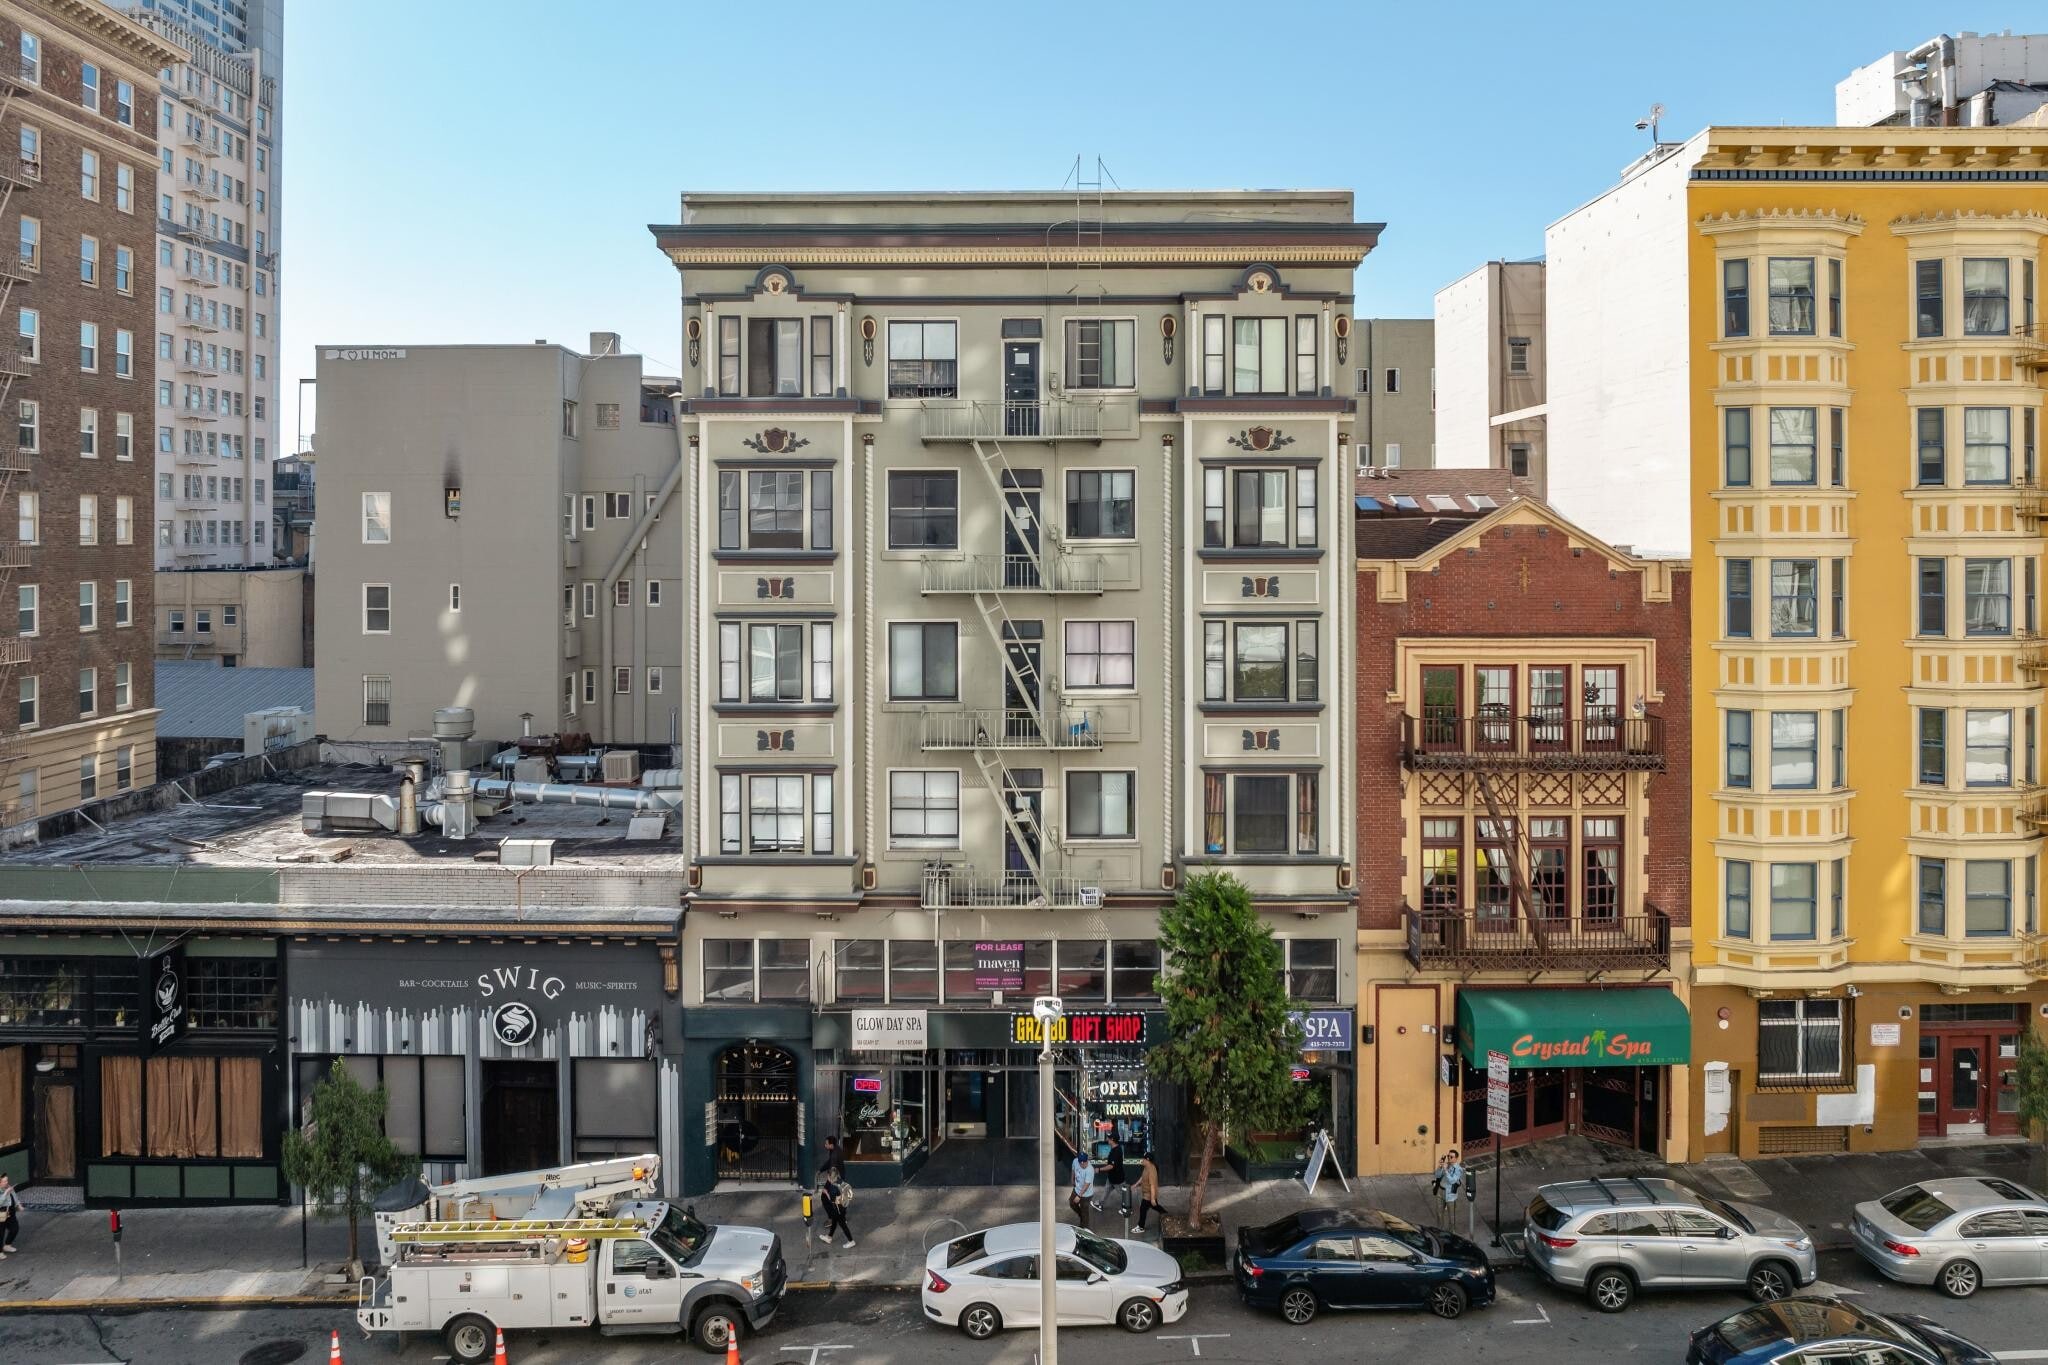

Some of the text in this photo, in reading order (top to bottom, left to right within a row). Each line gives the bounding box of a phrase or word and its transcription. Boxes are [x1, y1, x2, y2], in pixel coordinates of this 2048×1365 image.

[361, 350, 369, 361] U
[372, 350, 398, 360] MOM
[975, 943, 1024, 951] FOR LEASE
[977, 959, 1021, 969] maven
[477, 965, 566, 1000] SWIG
[856, 1017, 922, 1031] GLOW DAY SPA
[1016, 1016, 1141, 1042] GAZBO GIFT SHOP
[1305, 1017, 1342, 1038] SPA
[1512, 1033, 1652, 1060] Crystal Spa
[857, 1080, 880, 1090] OPEN
[1100, 1080, 1138, 1096] OPEN
[1106, 1103, 1145, 1115] KRATOM
